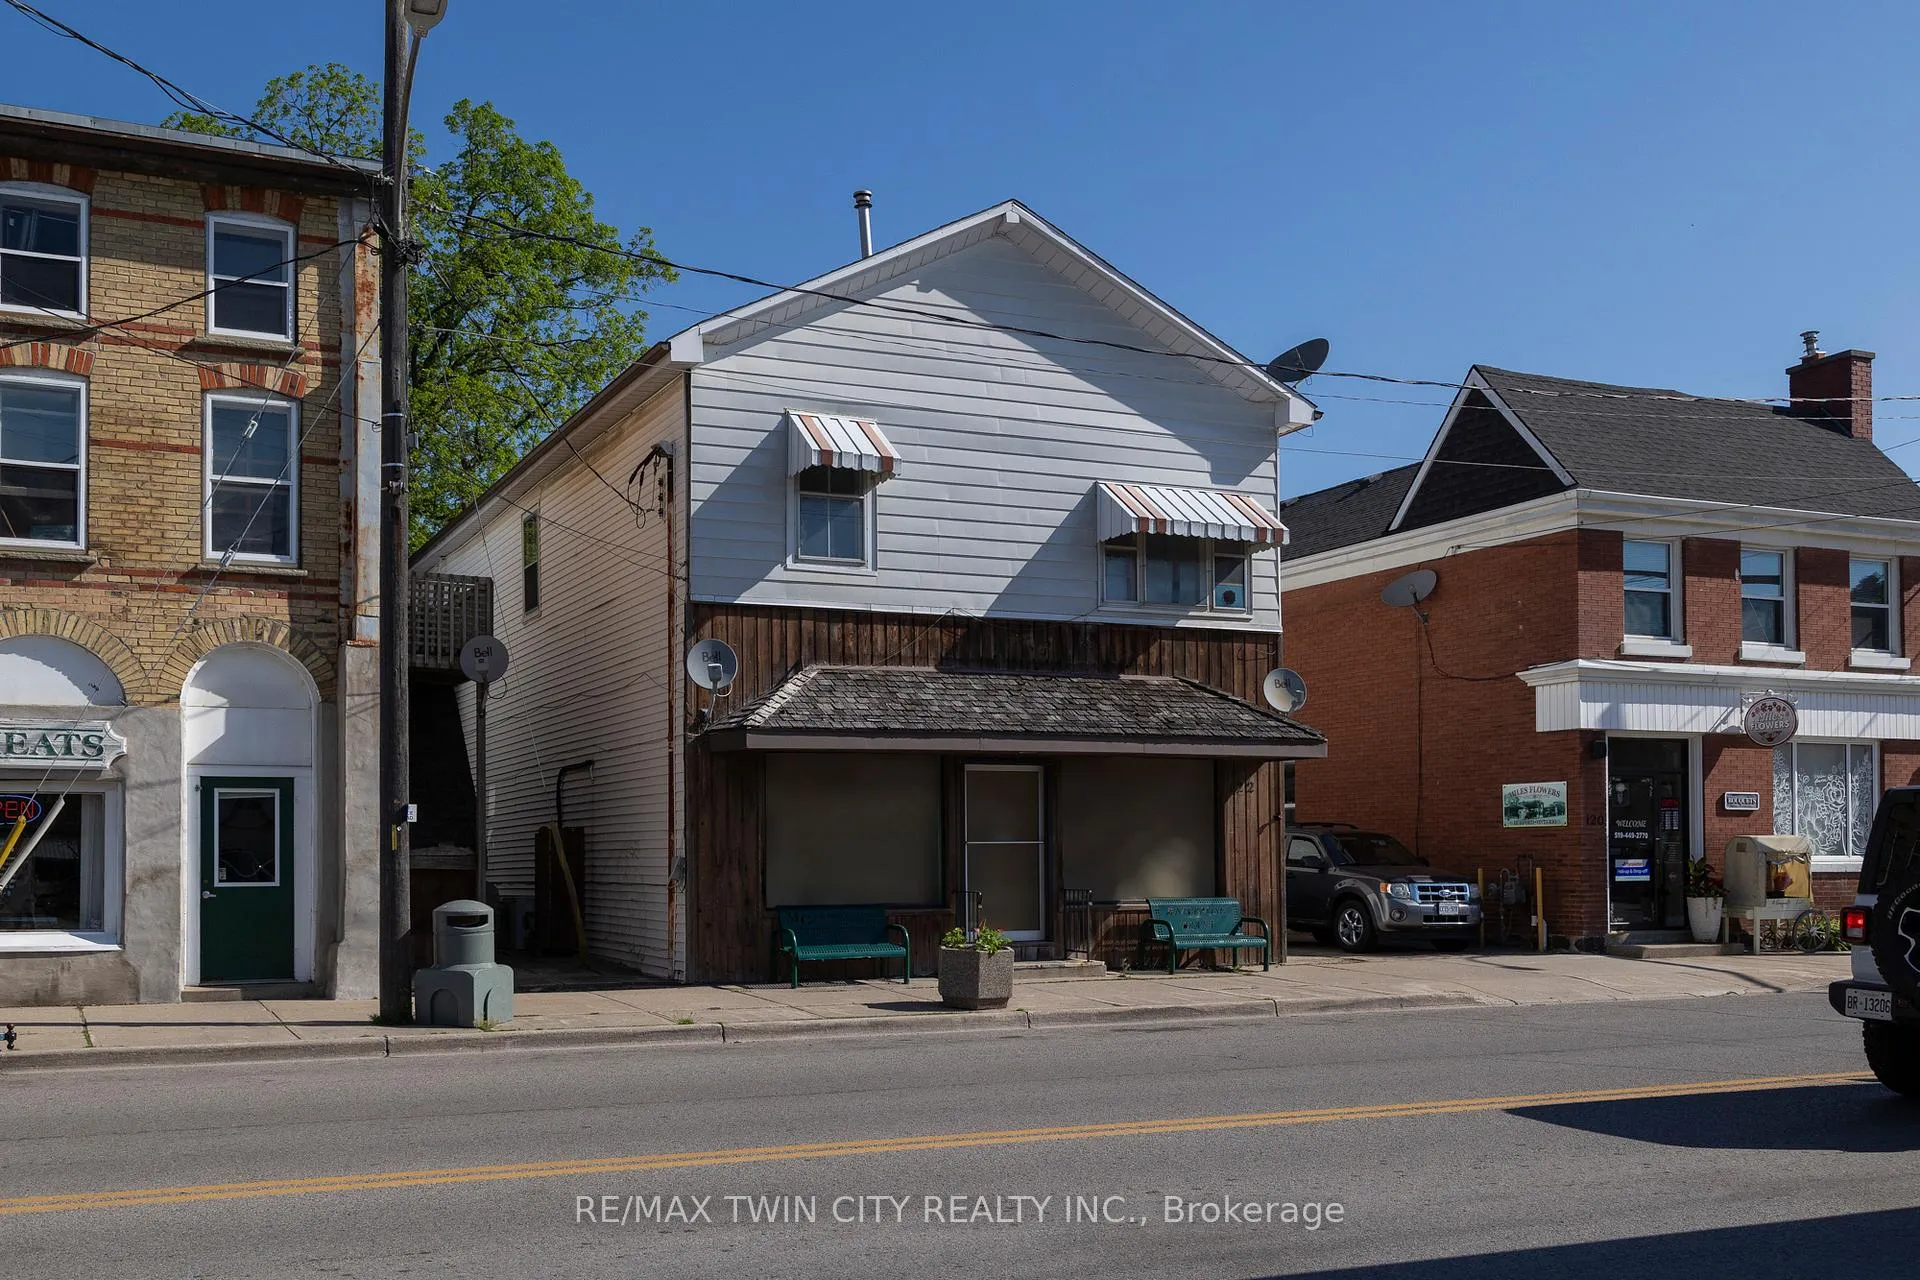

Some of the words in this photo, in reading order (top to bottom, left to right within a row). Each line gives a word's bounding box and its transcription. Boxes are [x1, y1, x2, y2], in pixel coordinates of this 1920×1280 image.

[474, 646, 493, 658] Bell
[702, 650, 721, 663] Bell
[1750, 720, 1790, 730] FLOWERS
[0, 731, 105, 757] EATS
[1528, 785, 1561, 798] FLOWERS
[1586, 814, 1604, 826] 120
[1616, 820, 1647, 828] WELCOME
[1614, 831, 1649, 839] 519-449-2770
